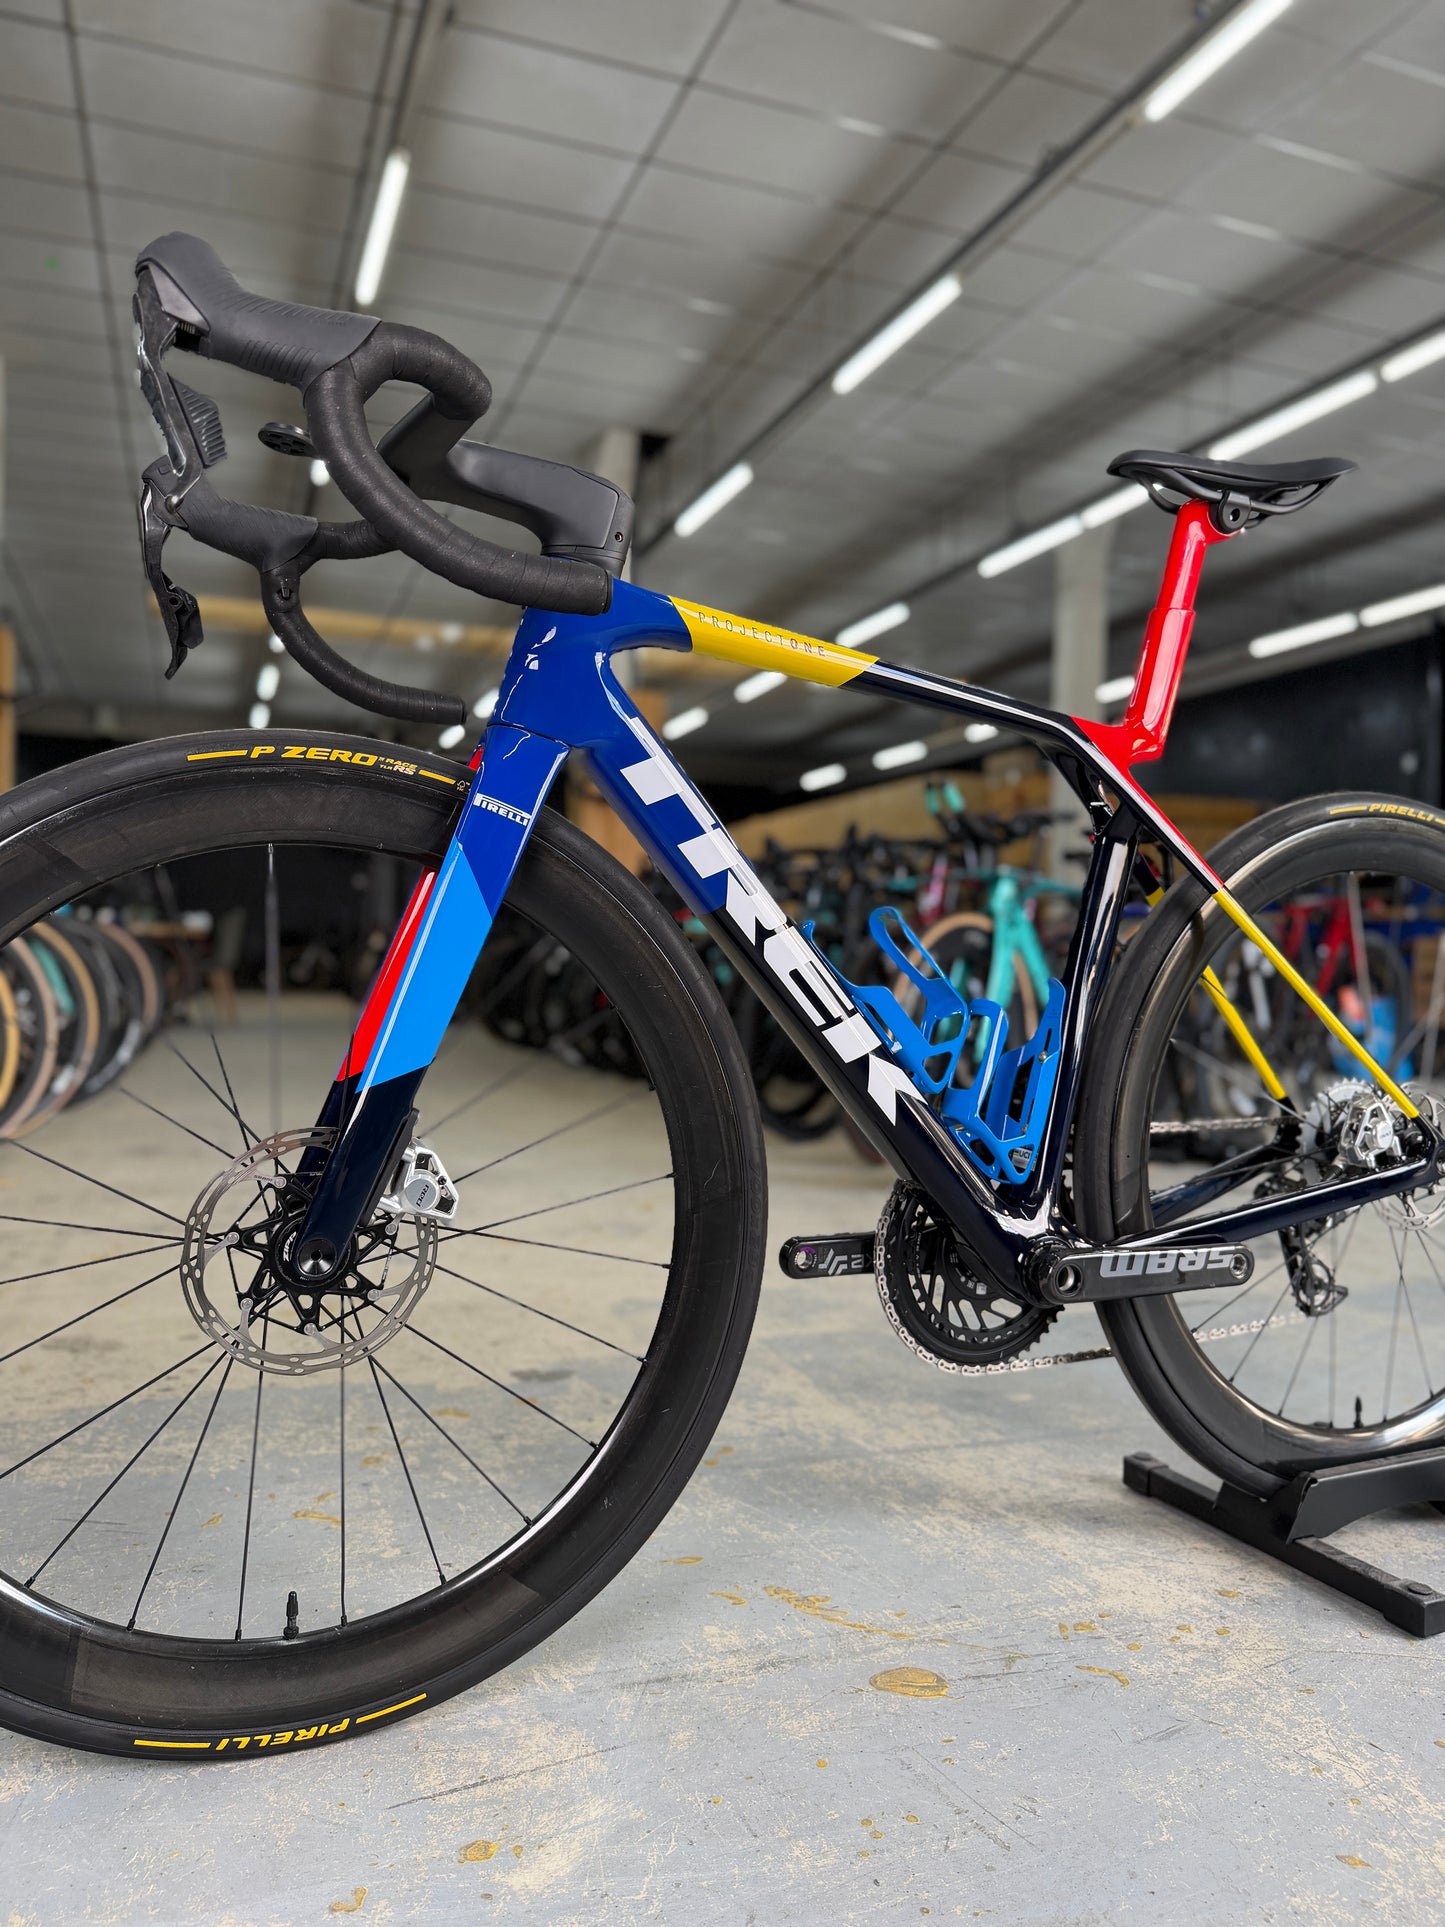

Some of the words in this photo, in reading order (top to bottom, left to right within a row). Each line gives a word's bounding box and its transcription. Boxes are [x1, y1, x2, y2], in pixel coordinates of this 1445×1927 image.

[250, 746, 276, 759] P
[281, 746, 378, 766] ZERO
[393, 765, 417, 776] RS
[473, 792, 532, 827] PIRELLI
[1368, 803, 1434, 822] PIRELLI
[620, 716, 928, 1127] TREK
[1100, 1247, 1234, 1279] SRAM
[217, 1717, 350, 1751] PIRELLI
